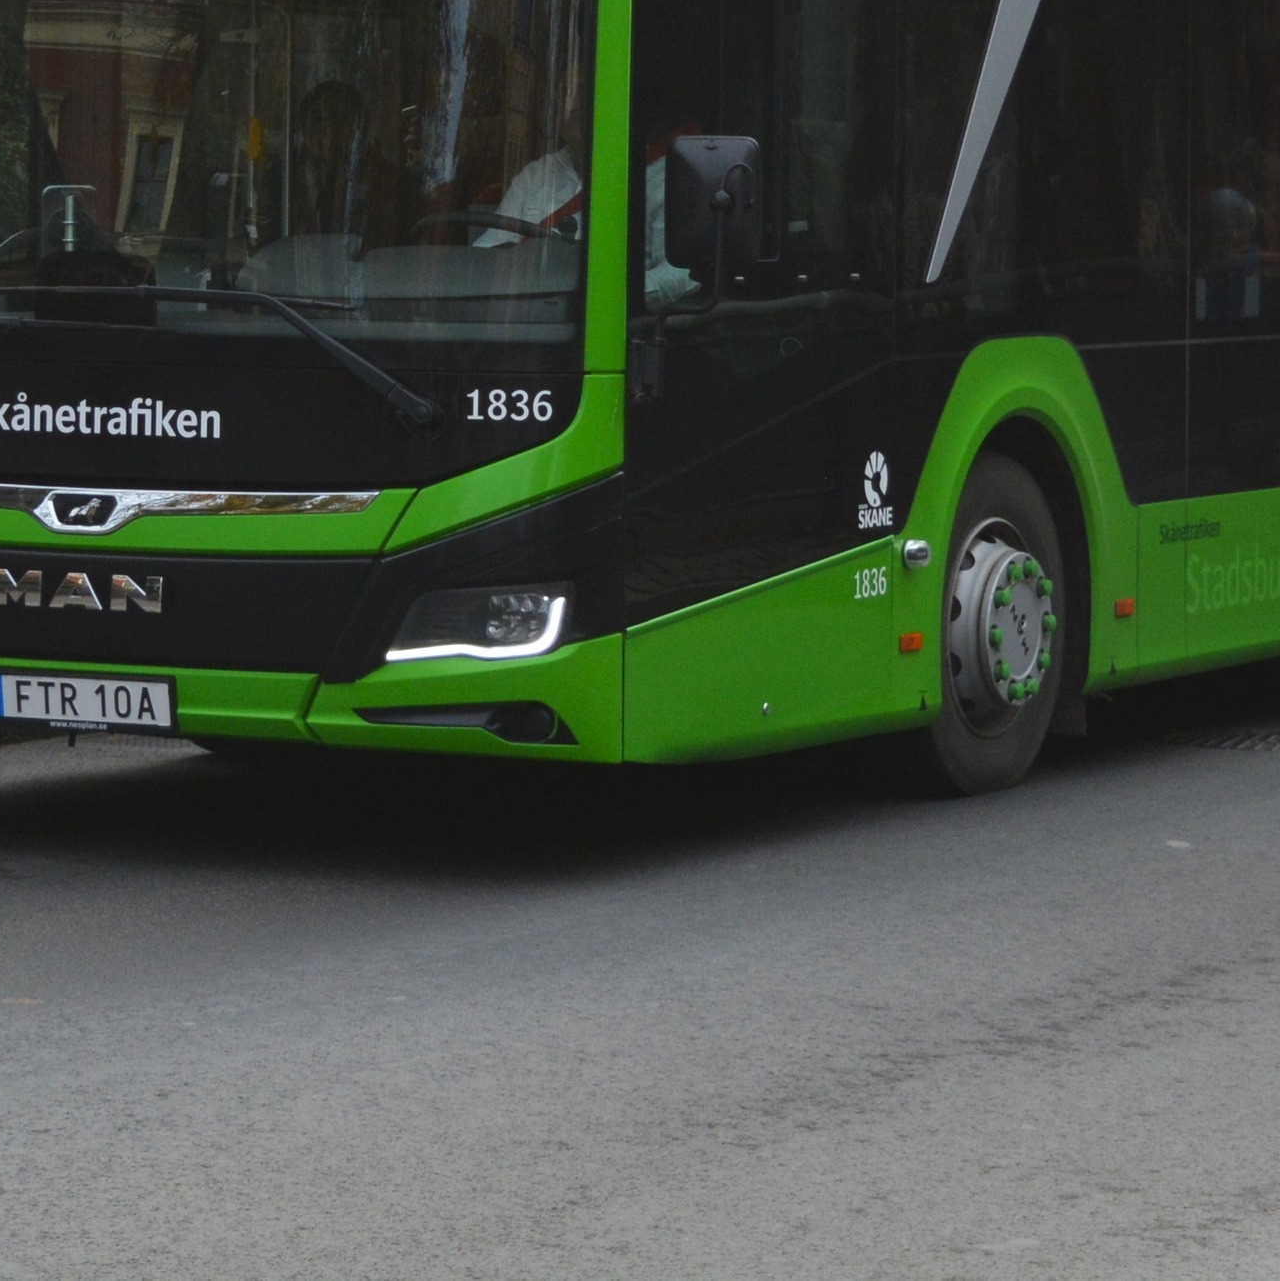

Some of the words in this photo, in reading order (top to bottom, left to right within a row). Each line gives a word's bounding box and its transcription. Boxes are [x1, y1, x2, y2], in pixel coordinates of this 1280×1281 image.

[465, 388, 554, 422] 1836
[1159, 518, 1221, 545] Skånetrafiken
[853, 566, 888, 600] 1836
[14, 679, 80, 717] FTR
[93, 683, 157, 721] 10A
[49, 719, 109, 731] www.neoplan.se
